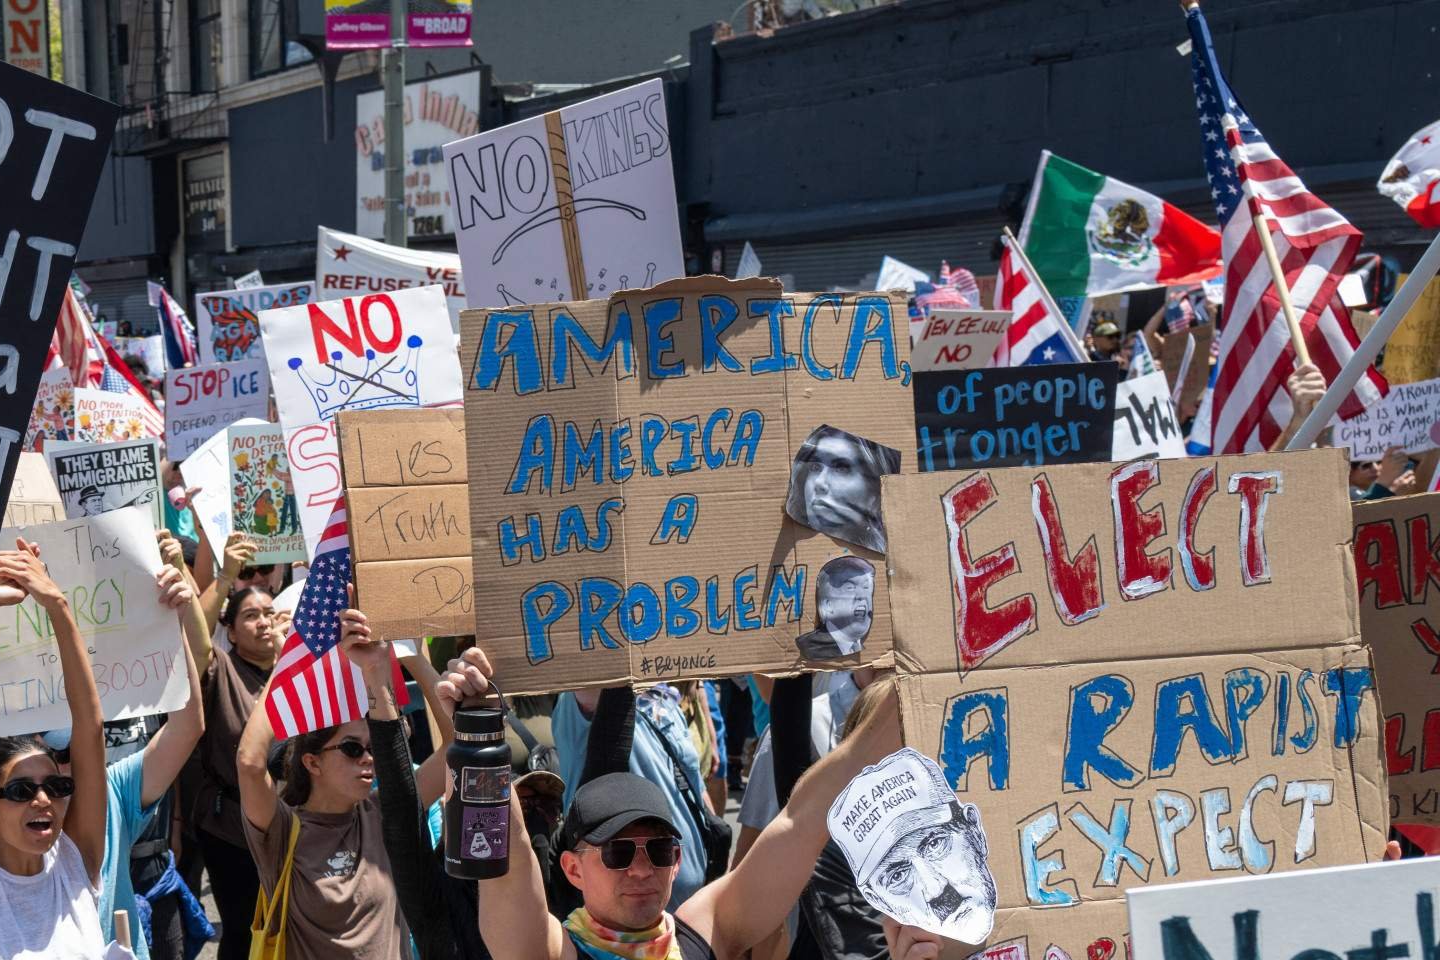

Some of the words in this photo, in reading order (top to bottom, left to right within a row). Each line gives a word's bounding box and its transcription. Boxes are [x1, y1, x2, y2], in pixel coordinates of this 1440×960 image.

[425, 17, 467, 35] BROAD
[451, 143, 550, 231] NO
[562, 93, 671, 192] KINGS
[209, 285, 311, 317] UNIDOS
[323, 274, 411, 291] REFUSE
[307, 293, 403, 364] NO
[468, 293, 914, 397] AMERICA,
[934, 344, 972, 365] NO
[174, 368, 230, 406] STOP
[232, 370, 259, 398] ICE
[937, 371, 984, 416] of
[995, 373, 1107, 422] people
[172, 414, 216, 436] DEFEND
[232, 436, 256, 452] NO
[504, 406, 766, 498] AMERICA
[60, 461, 155, 491] IMMIGRANTS
[62, 454, 101, 474] THEY
[102, 446, 150, 468] BLAME
[64, 524, 121, 564] This
[365, 492, 466, 555] Truth
[497, 496, 626, 568] HAS
[649, 492, 700, 546] A
[939, 459, 1285, 683] ELECT
[520, 563, 808, 666] PROBLEM
[939, 686, 1010, 794] A
[1062, 665, 1378, 795] RAPIST
[841, 794, 873, 833] MAKE
[871, 770, 915, 800] AMERICA
[852, 806, 883, 843] GREAT
[882, 785, 918, 815] AGAIN
[1015, 774, 1334, 908] EXPECT
